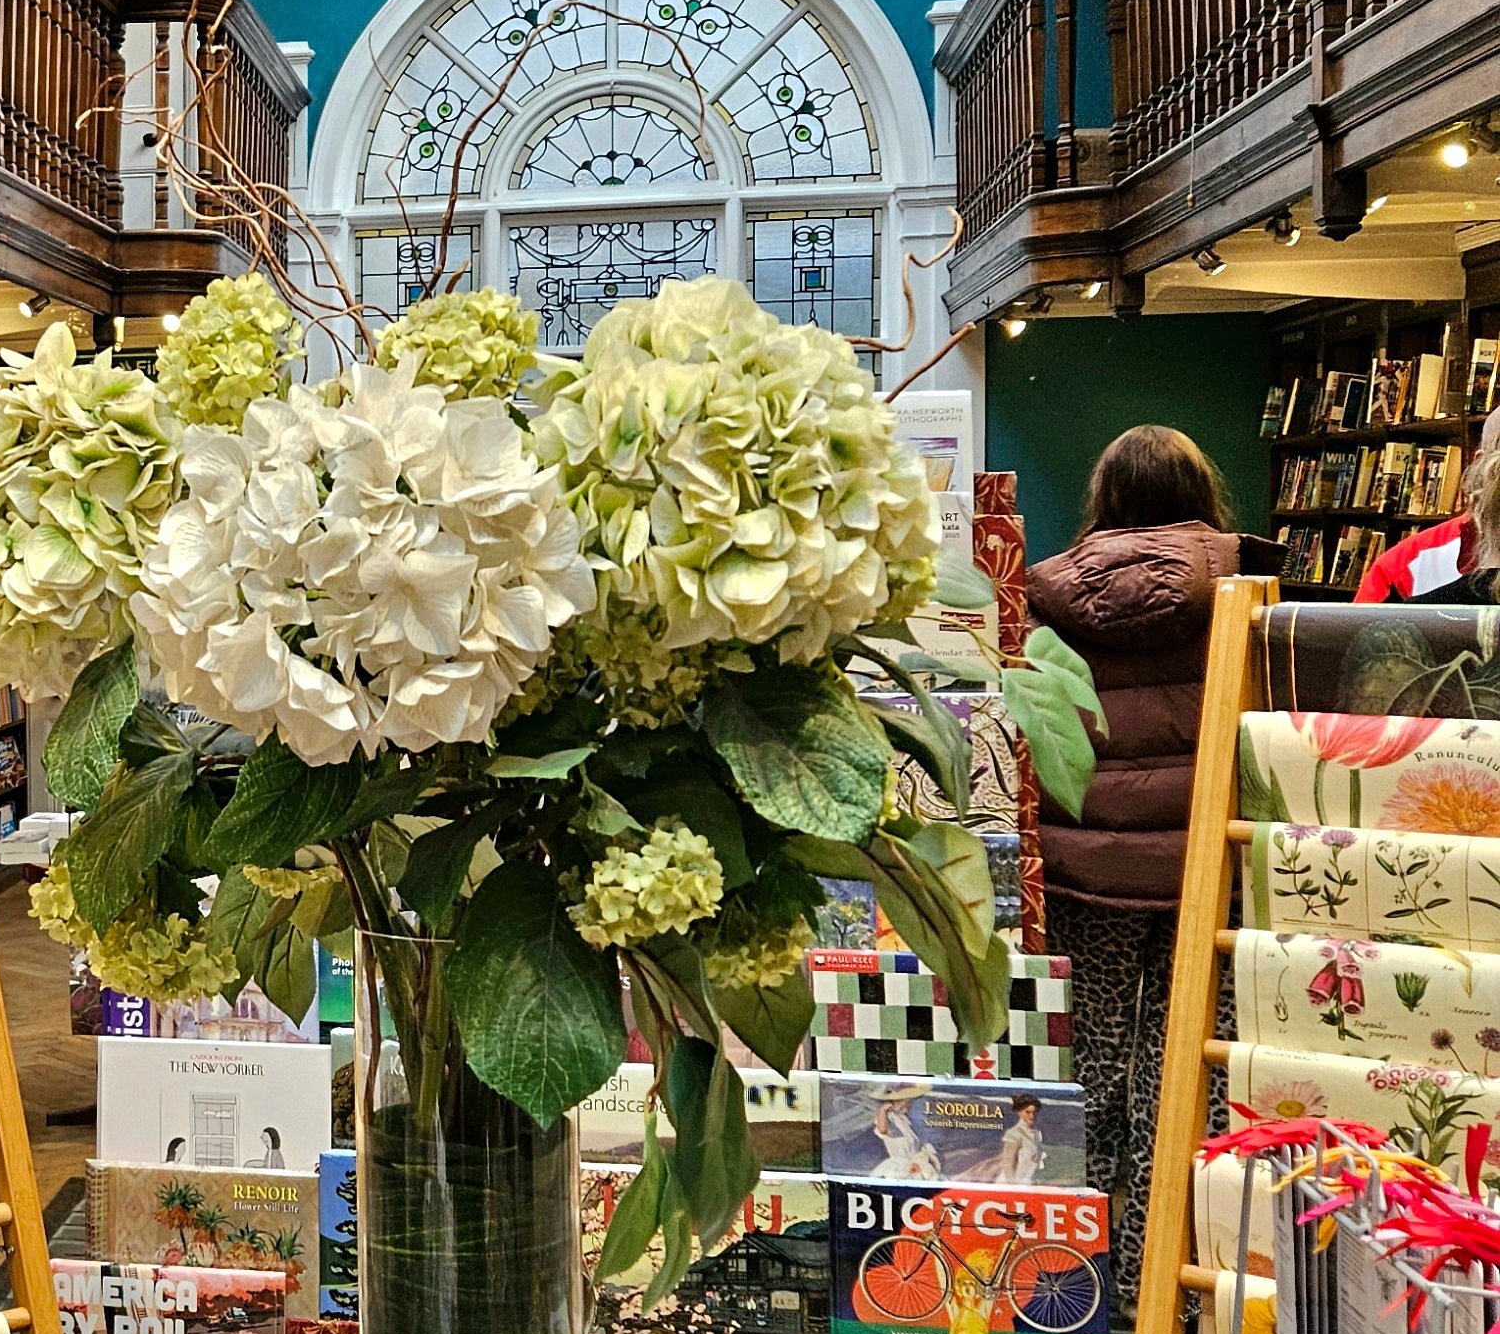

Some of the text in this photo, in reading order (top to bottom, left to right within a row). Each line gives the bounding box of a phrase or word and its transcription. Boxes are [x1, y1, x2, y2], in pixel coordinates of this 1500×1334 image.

[912, 407, 963, 416] HEPWORTH
[826, 954, 875, 965] PAUL KLEE
[169, 1061, 264, 1076] THE NEW YORKER
[935, 1101, 1004, 1119] SOROLLA
[233, 1183, 299, 1202] RENOIR
[234, 1201, 299, 1214] Flower Still Life
[846, 1191, 1101, 1243] BICYCLES
[52, 1272, 198, 1314] AMERICA
